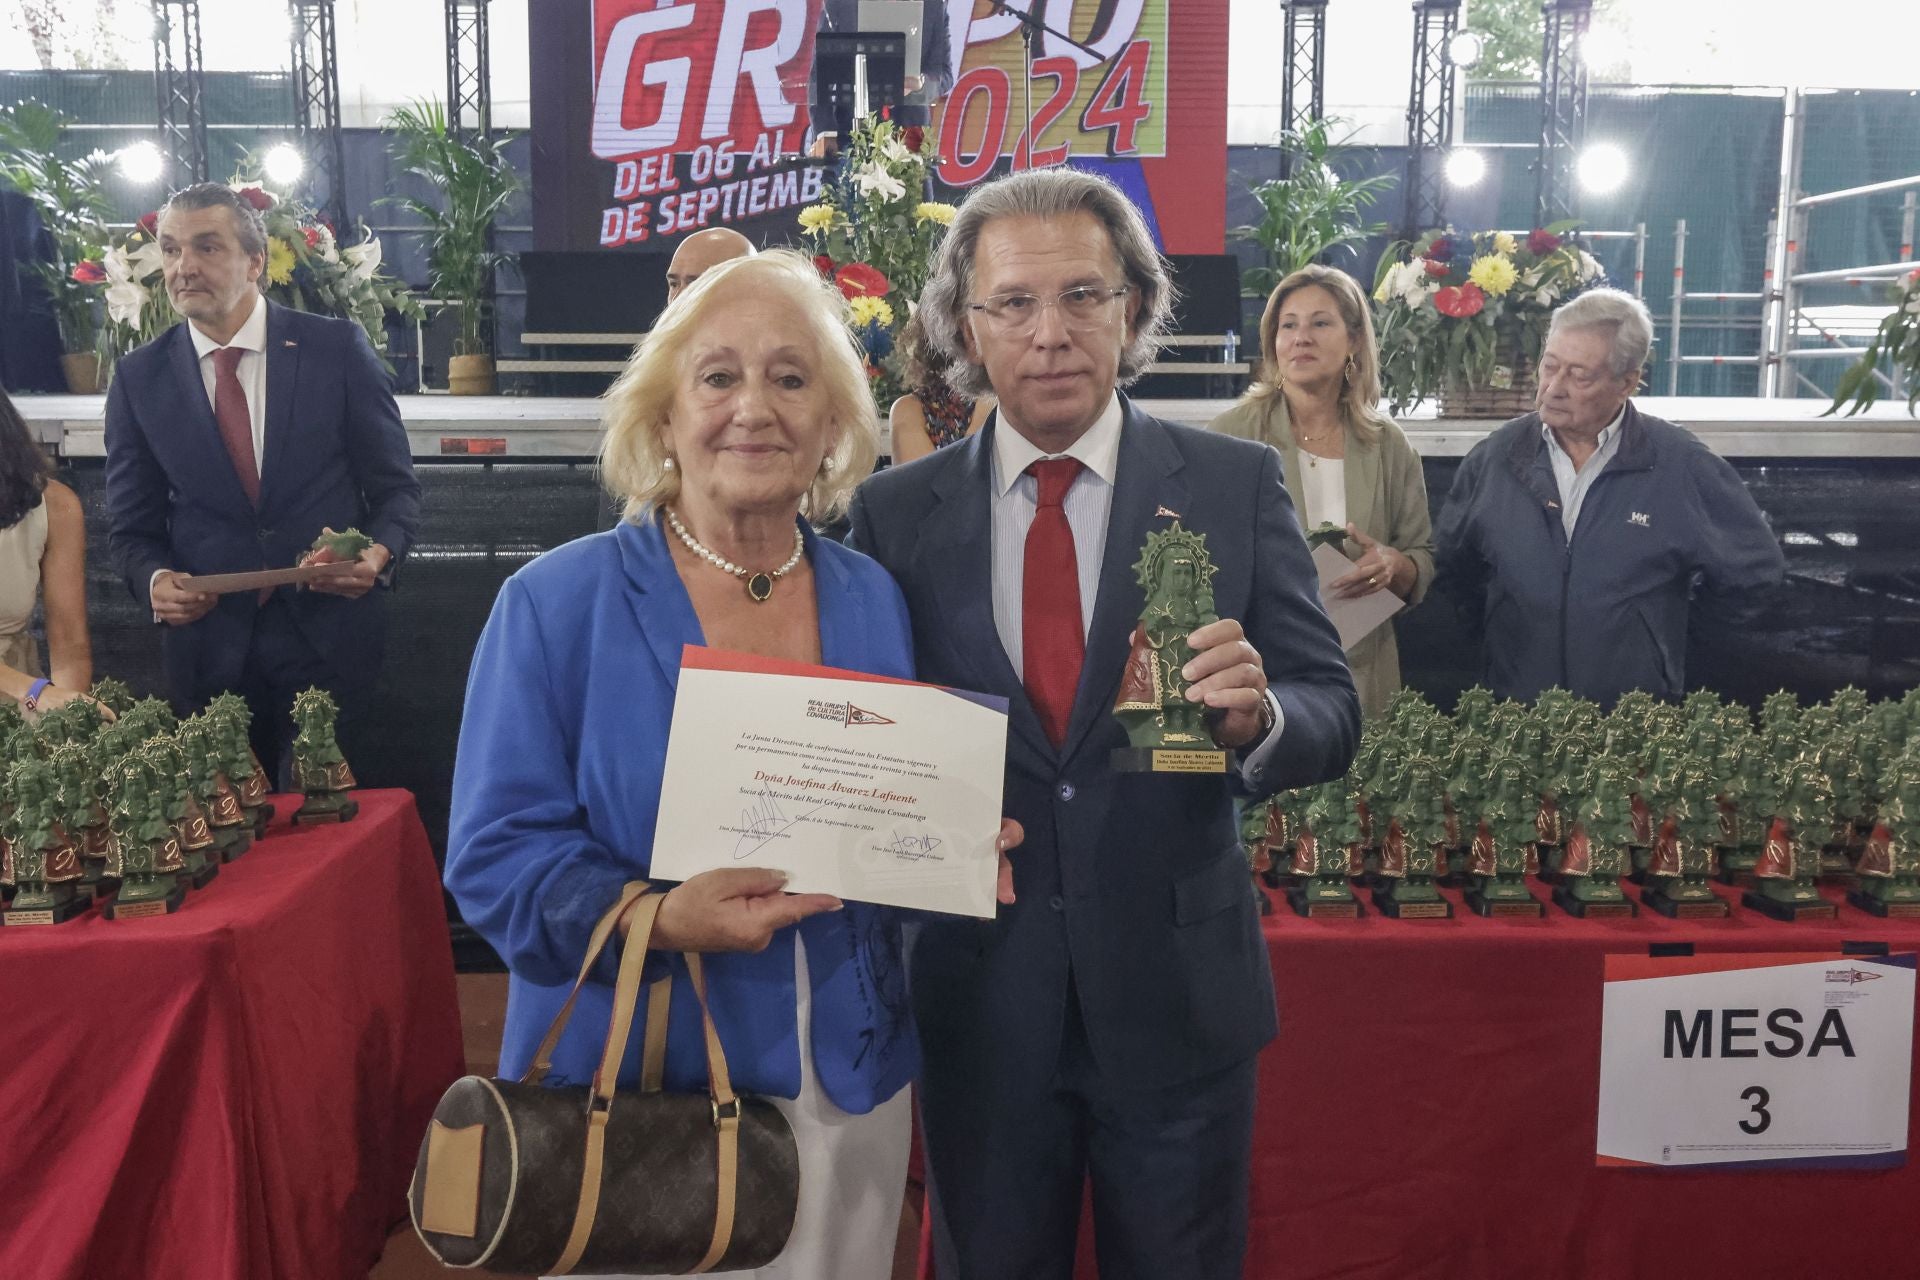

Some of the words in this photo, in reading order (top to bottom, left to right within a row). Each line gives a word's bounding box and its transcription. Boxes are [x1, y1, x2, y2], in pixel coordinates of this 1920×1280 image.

[936, 38, 1152, 187] 024
[613, 153, 677, 199] DEL
[690, 139, 736, 182] 06
[600, 202, 646, 245] DE
[656, 167, 824, 233] SEPTIEMB
[806, 711, 845, 722] COVADONGA
[807, 699, 824, 707] REAL
[824, 701, 846, 711] GRUPO
[817, 707, 846, 716] CULTURA
[752, 734, 771, 742] Junta
[772, 736, 805, 748] Directiva,
[814, 744, 855, 756] conformidad
[876, 753, 905, 764] Estatutos
[906, 760, 932, 769] vigentes
[755, 746, 798, 757] permanencia
[831, 757, 857, 766] durante
[880, 765, 902, 774] treinta
[753, 770, 784, 783] Doña
[783, 775, 826, 790] Josefina
[827, 779, 870, 797] Álvarez
[870, 788, 917, 804] Lafuente
[811, 764, 841, 774] dispuesto
[841, 770, 869, 779] nombrar
[739, 786, 757, 795] Socia
[757, 789, 766, 797] de
[793, 794, 806, 802] del
[805, 796, 823, 804] Real
[824, 798, 847, 809] Grupo
[857, 803, 886, 815] Cultura
[887, 808, 927, 822] Covadonga
[824, 819, 853, 828] Septiembre
[1663, 1007, 1857, 1059] MESA
[1738, 1085, 1772, 1135] 3
